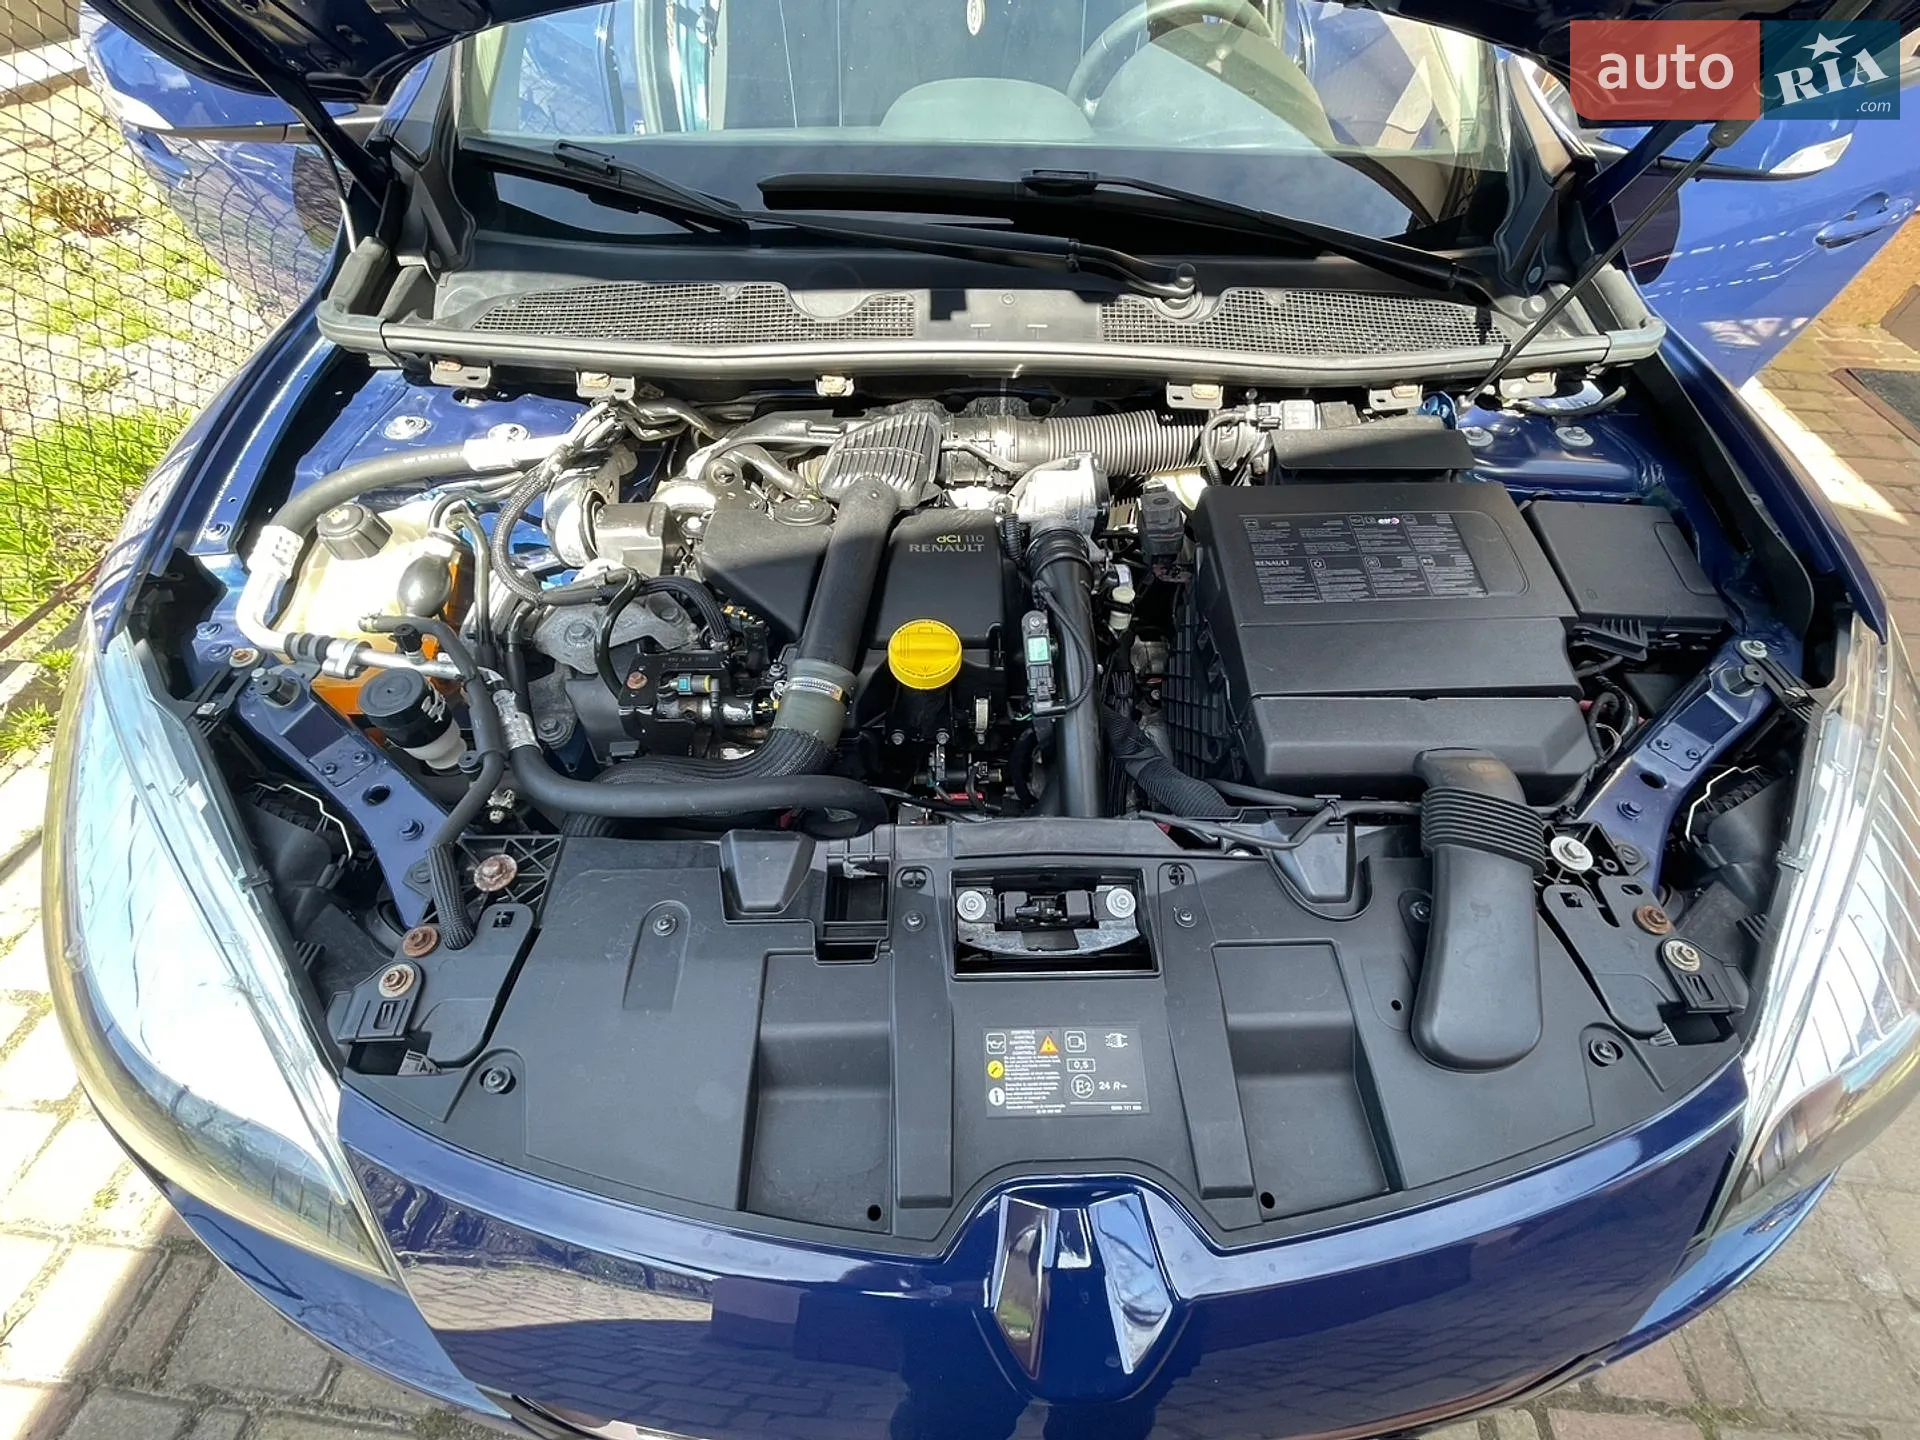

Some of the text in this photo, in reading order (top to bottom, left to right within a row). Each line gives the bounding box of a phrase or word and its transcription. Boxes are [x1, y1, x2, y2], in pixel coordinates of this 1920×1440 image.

[965, 534, 985, 543] 110
[908, 543, 985, 553] RENAULT
[1254, 559, 1290, 567] RENAULT
